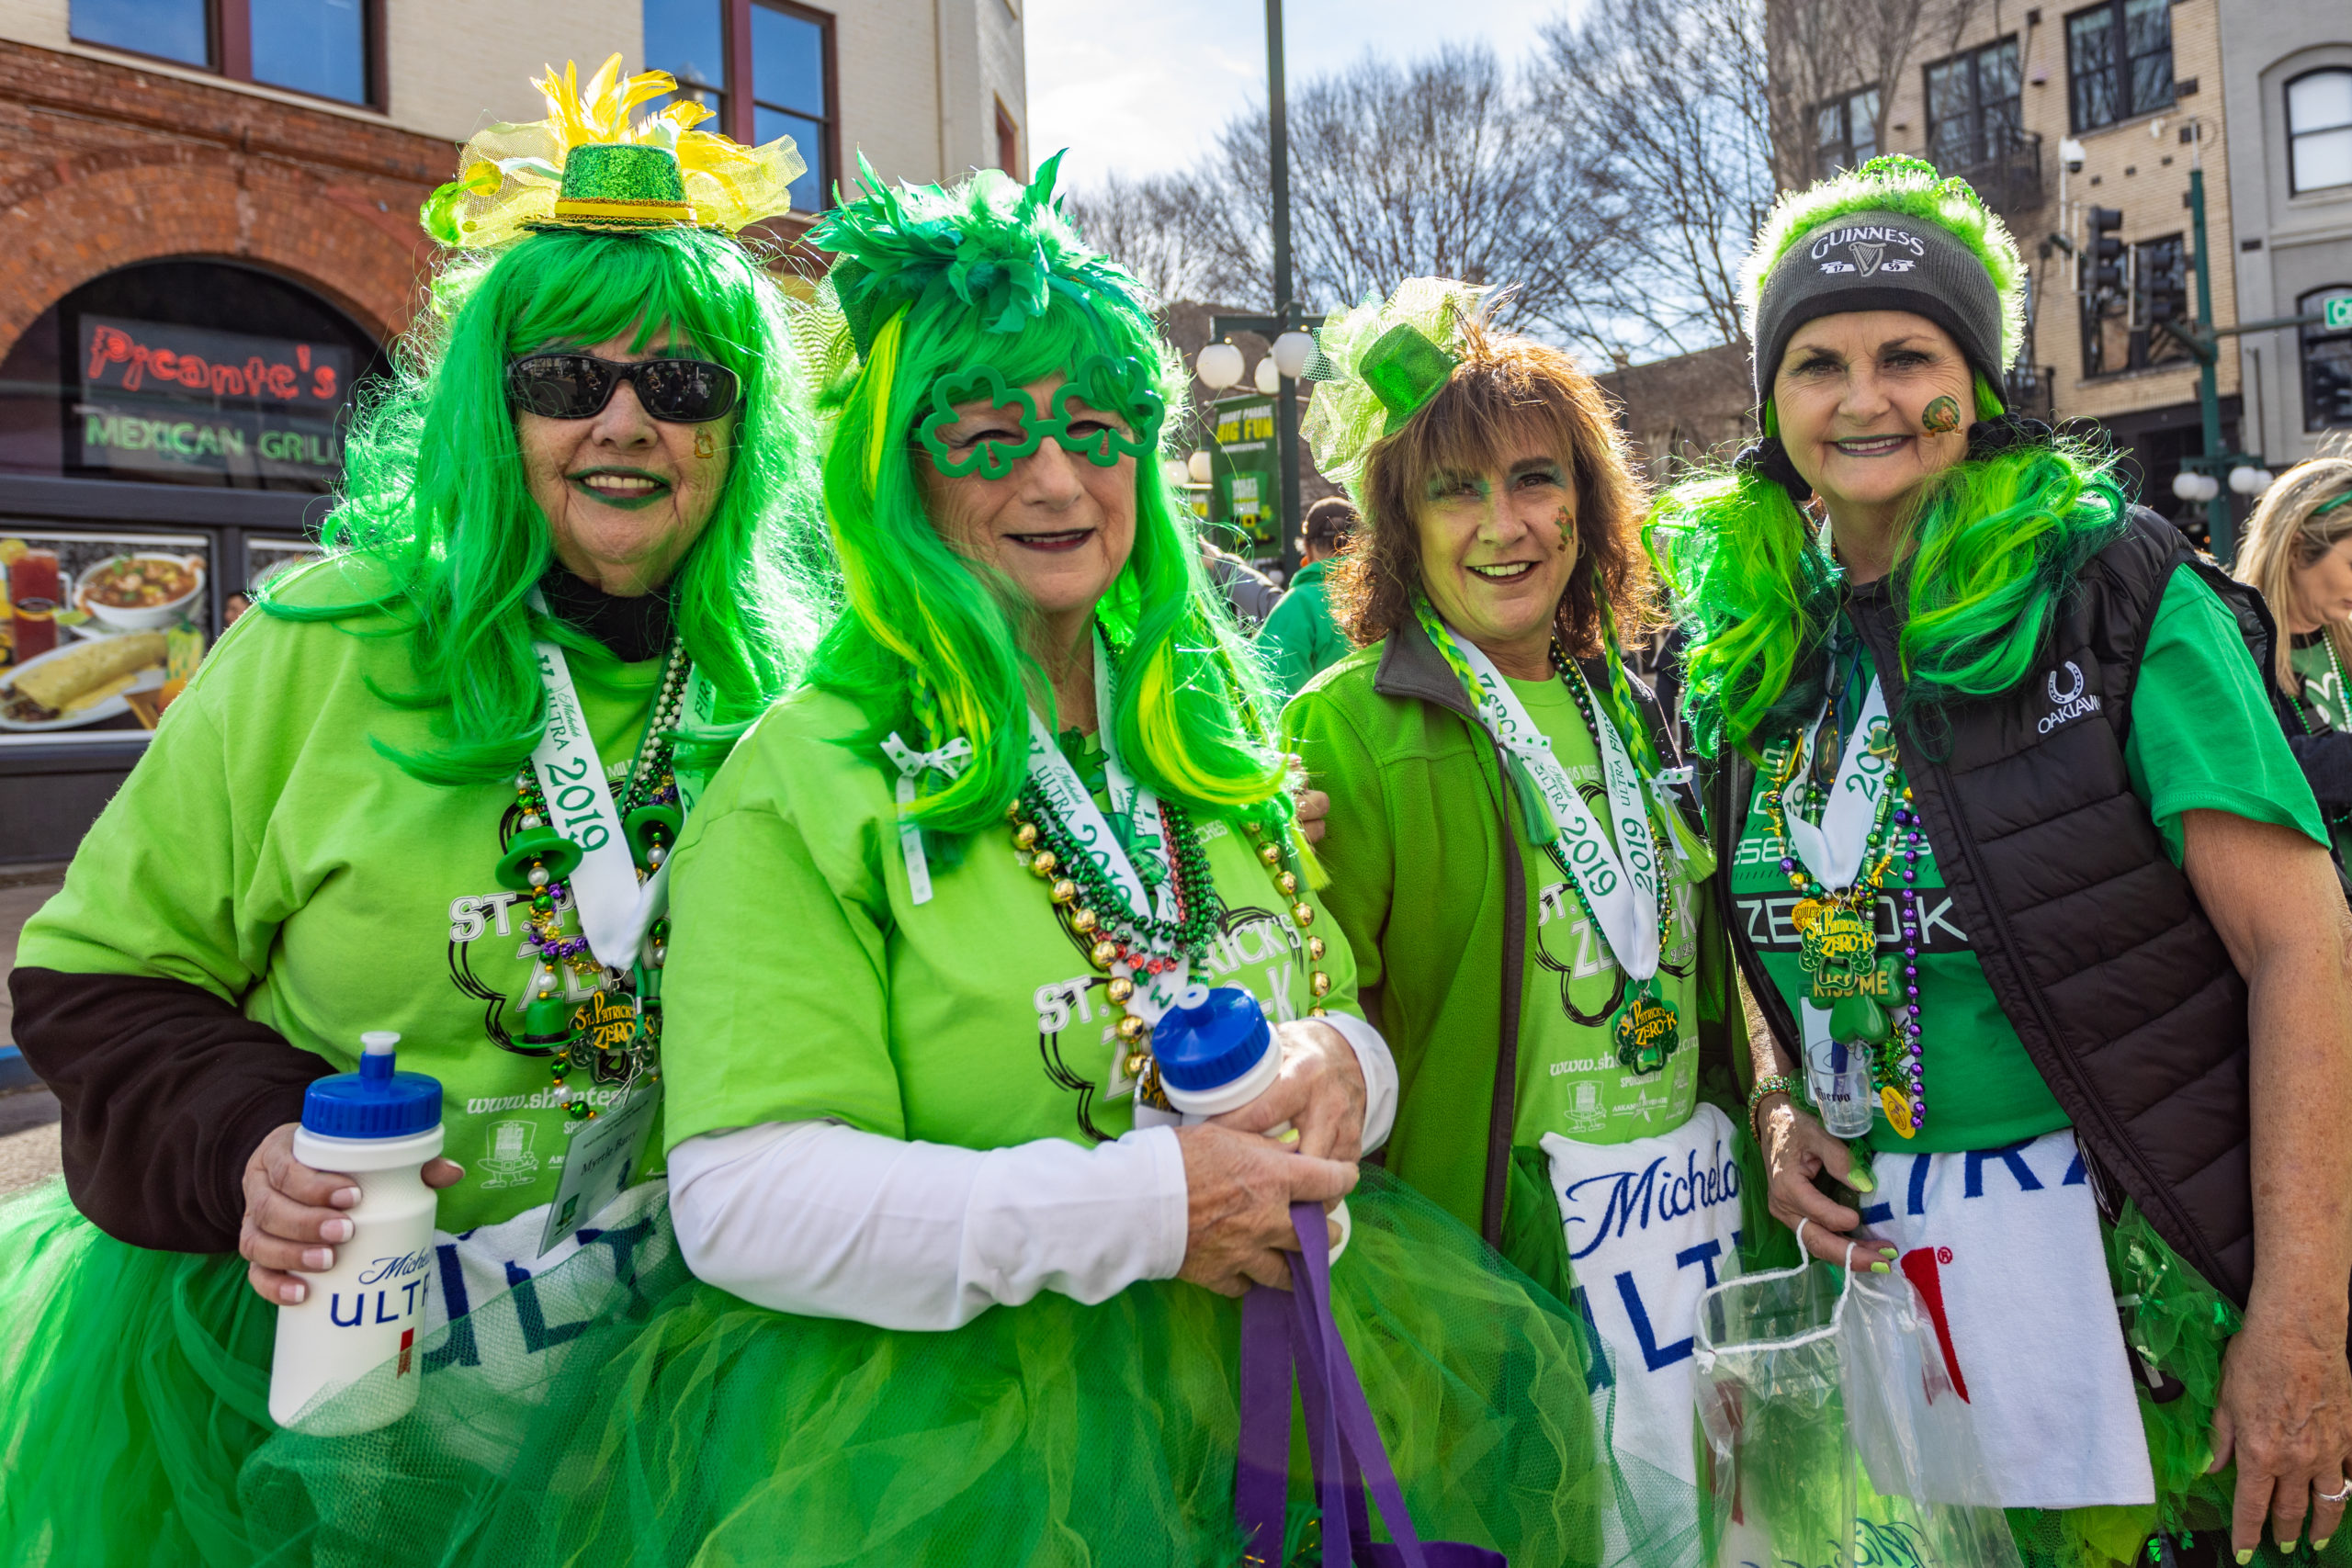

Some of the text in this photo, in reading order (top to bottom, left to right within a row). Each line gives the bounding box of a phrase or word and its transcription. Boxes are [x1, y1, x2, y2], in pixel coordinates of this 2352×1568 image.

[1810, 226, 1926, 260] GUINNESS
[1832, 263, 1901, 273] 17 59
[88, 324, 338, 400] Picante's
[85, 415, 245, 457] MEXICAN
[1216, 416, 1274, 443] BIG FUN
[556, 692, 582, 738] Michelob
[694, 680, 713, 723] FIR
[1035, 764, 1077, 823] ULTRA
[1053, 766, 1085, 806] Michelob
[1547, 763, 1575, 800] Michelob
[1613, 760, 1632, 807] ULTRA
[545, 755, 611, 853] 2019
[1559, 815, 1618, 897] 2019
[1621, 817, 1655, 897] 2019
[1736, 896, 1970, 945] ZEO-K
[1199, 912, 1302, 981] RICK'S
[1820, 931, 1875, 957] ZERO-K
[1859, 970, 1889, 996] ME
[593, 1014, 655, 1050] ZEROK
[1634, 1010, 1678, 1045] ZERO-K
[1562, 1139, 1743, 1262] Michelo
